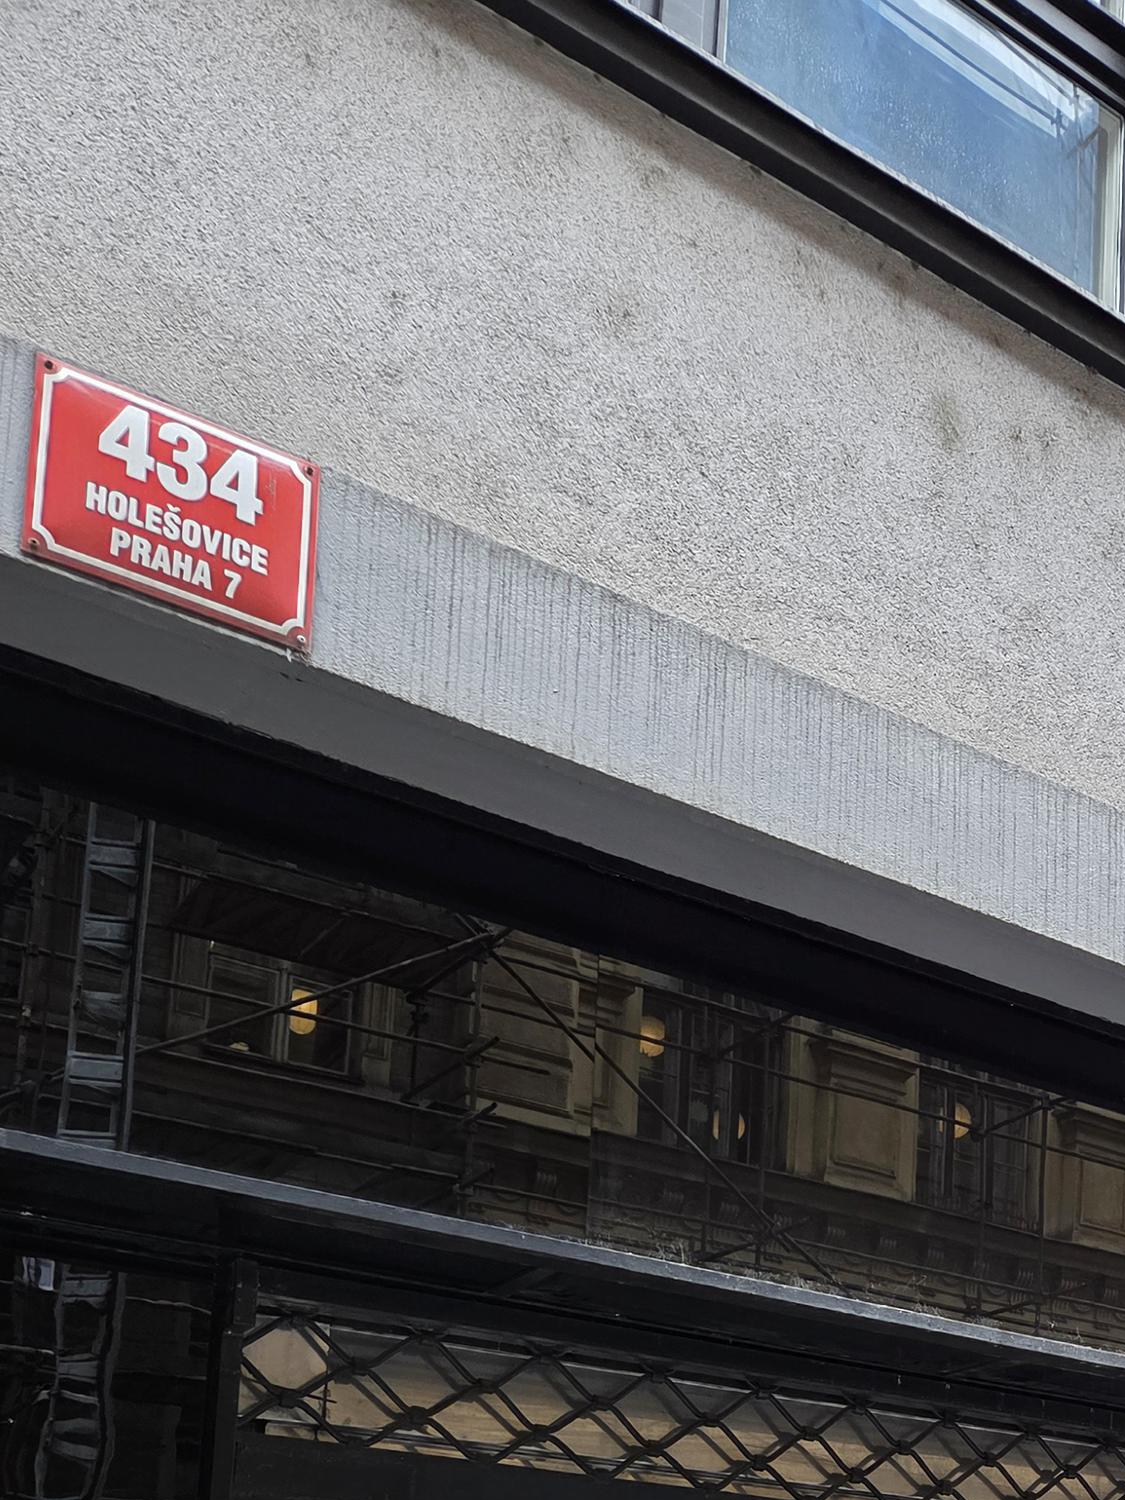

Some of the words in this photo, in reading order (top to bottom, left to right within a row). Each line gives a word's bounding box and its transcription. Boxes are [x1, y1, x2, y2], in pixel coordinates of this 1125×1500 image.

[98, 404, 264, 526] 434
[86, 482, 269, 575] HOLEŠOVICE
[110, 527, 212, 592] PRAHA
[224, 569, 242, 599] 7
